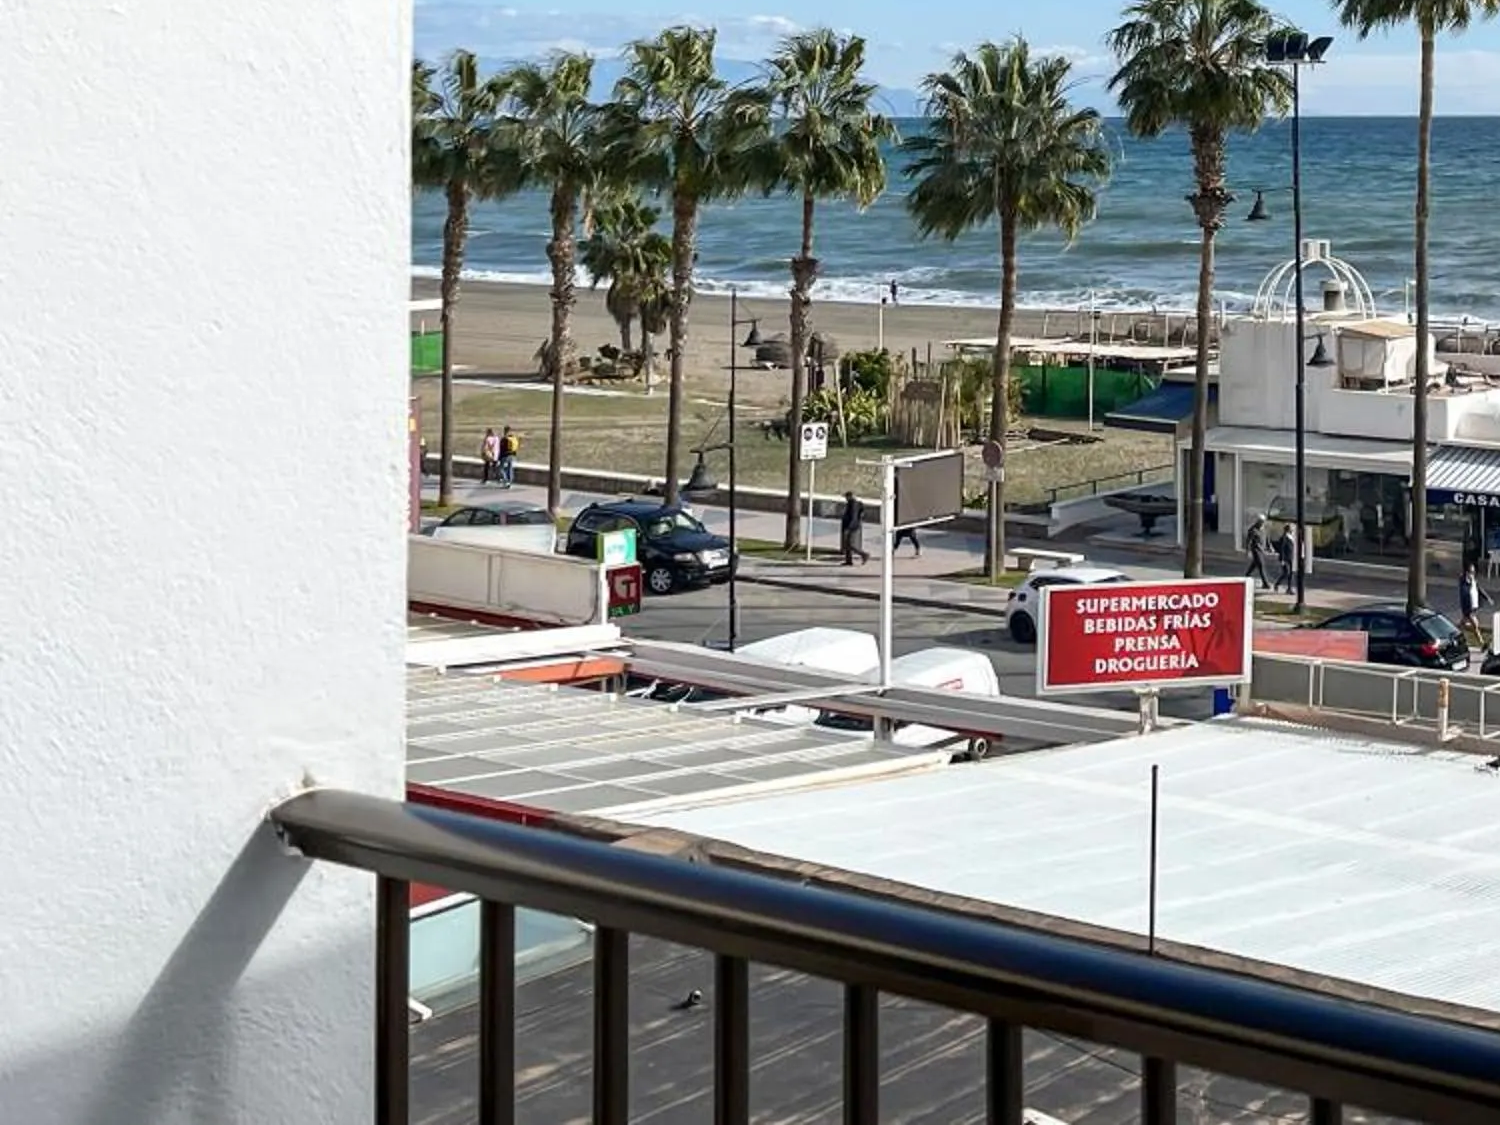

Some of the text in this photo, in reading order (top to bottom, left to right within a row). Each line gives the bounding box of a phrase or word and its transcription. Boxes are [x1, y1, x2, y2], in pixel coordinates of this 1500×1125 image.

[1453, 492, 1500, 508] CASA
[1076, 592, 1219, 614] SUPERMERCADO
[1083, 610, 1212, 635] BEBIDAS FRÍAS
[1113, 634, 1181, 652] PRENSA
[1094, 650, 1200, 674] DROGUERÍA
